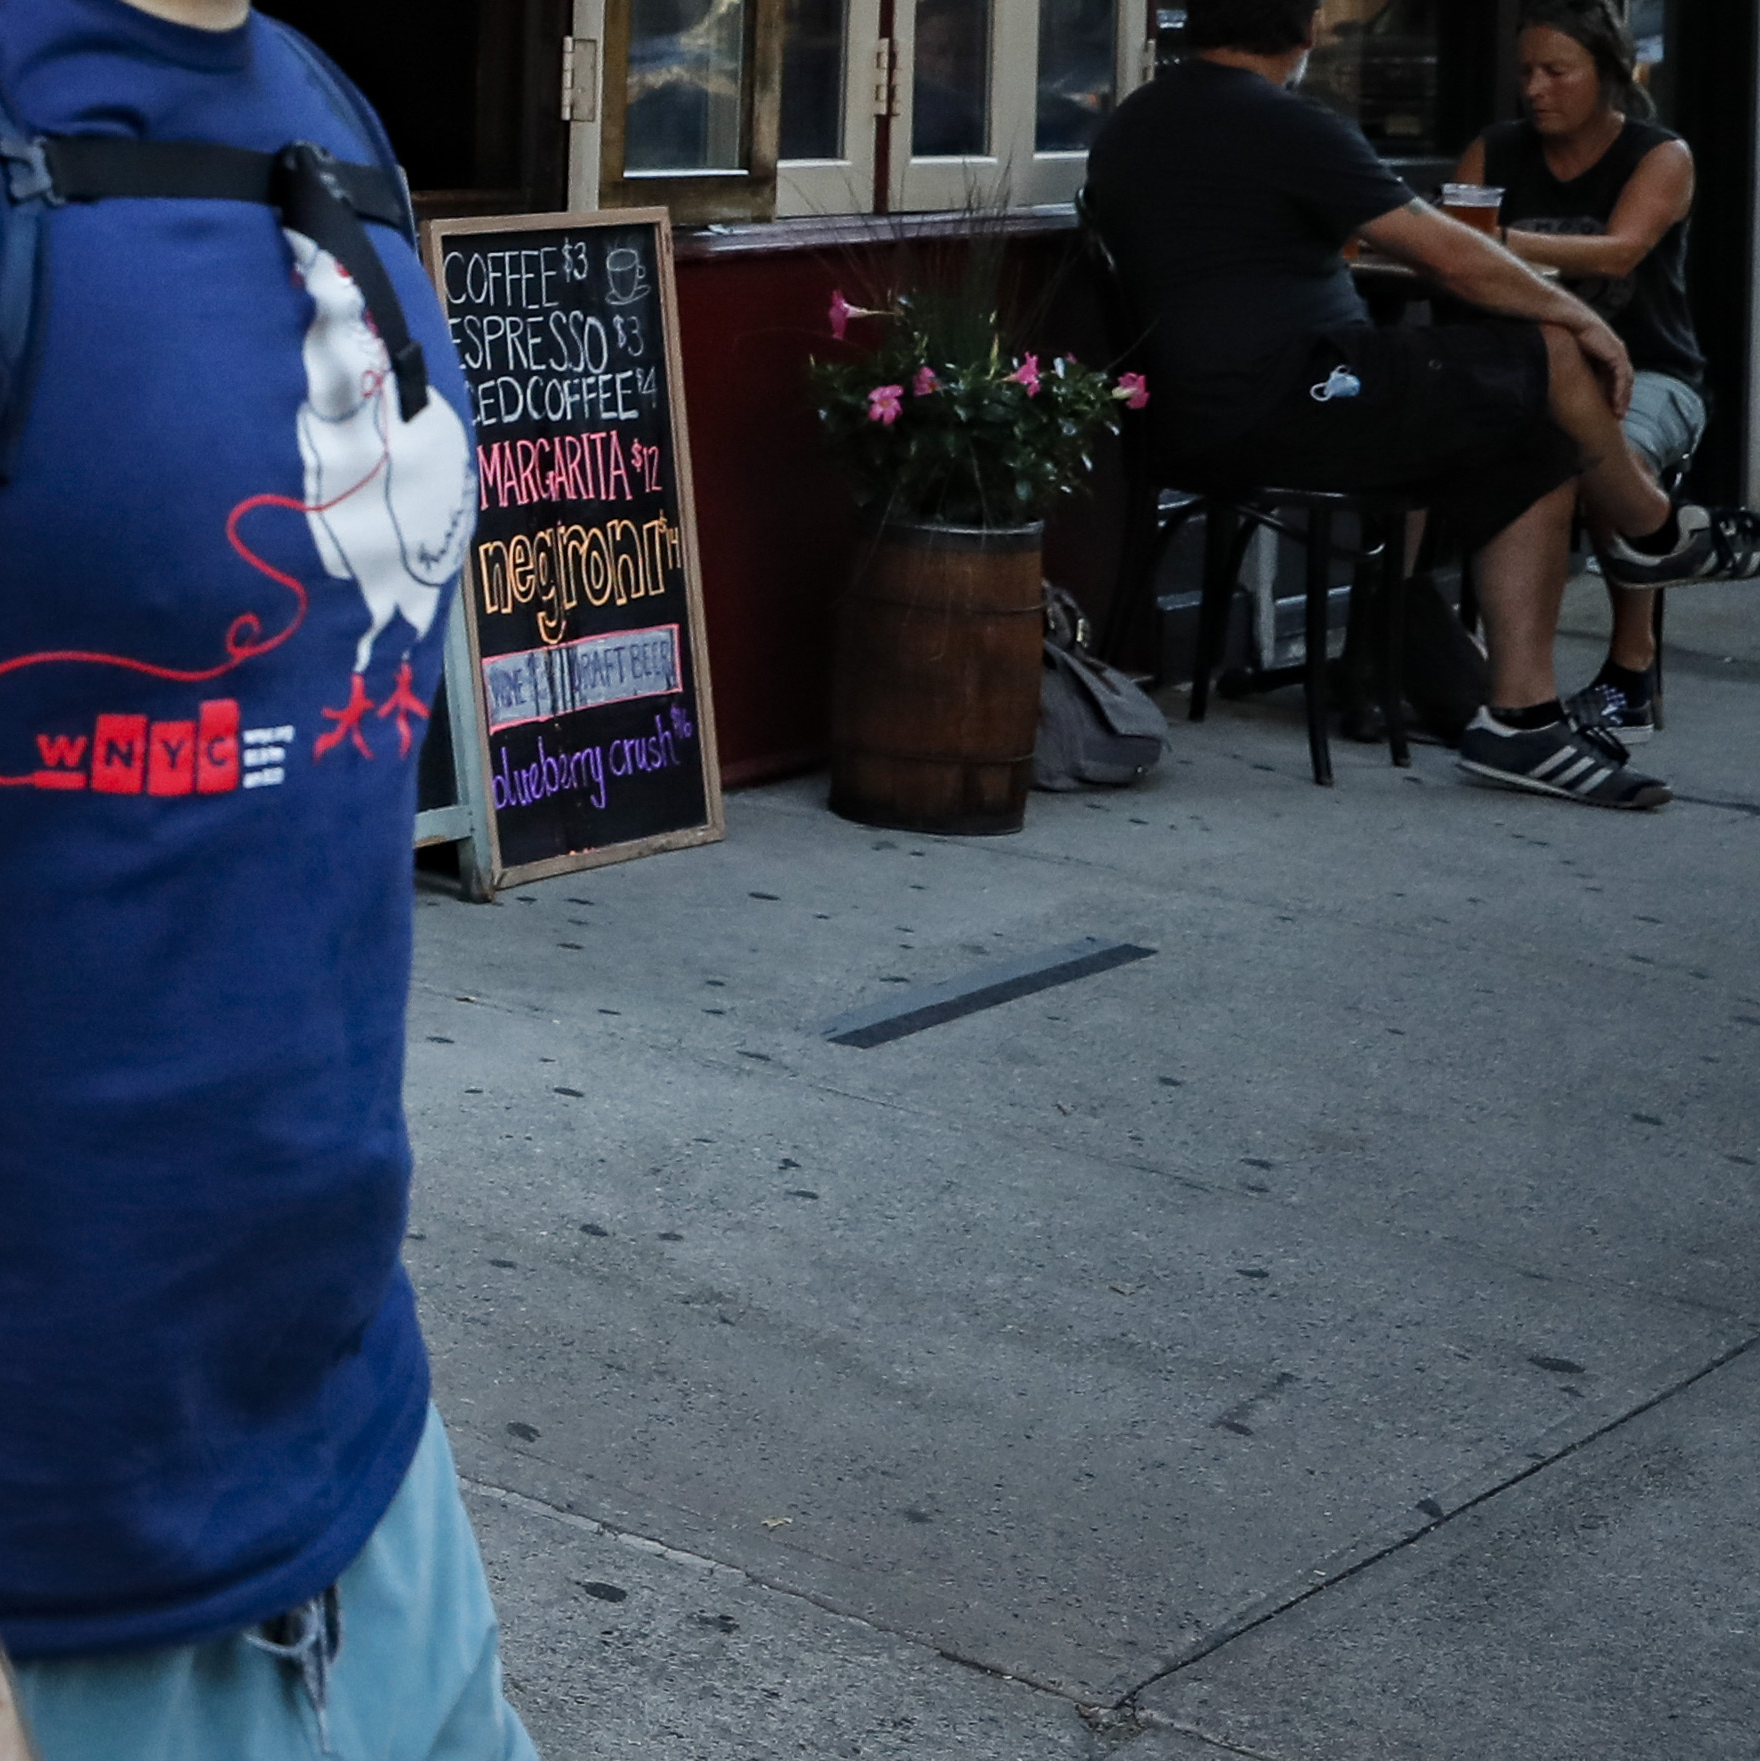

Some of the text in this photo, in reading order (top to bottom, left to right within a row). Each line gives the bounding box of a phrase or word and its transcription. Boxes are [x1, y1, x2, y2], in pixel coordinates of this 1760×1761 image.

[443, 237, 588, 310] COFFEE $3
[447, 309, 644, 374] ESPRESSO $3
[466, 376, 524, 427] ED
[526, 370, 639, 422] COFFEE
[476, 429, 663, 511] MARGARITA $12
[609, 714, 681, 776] crush
